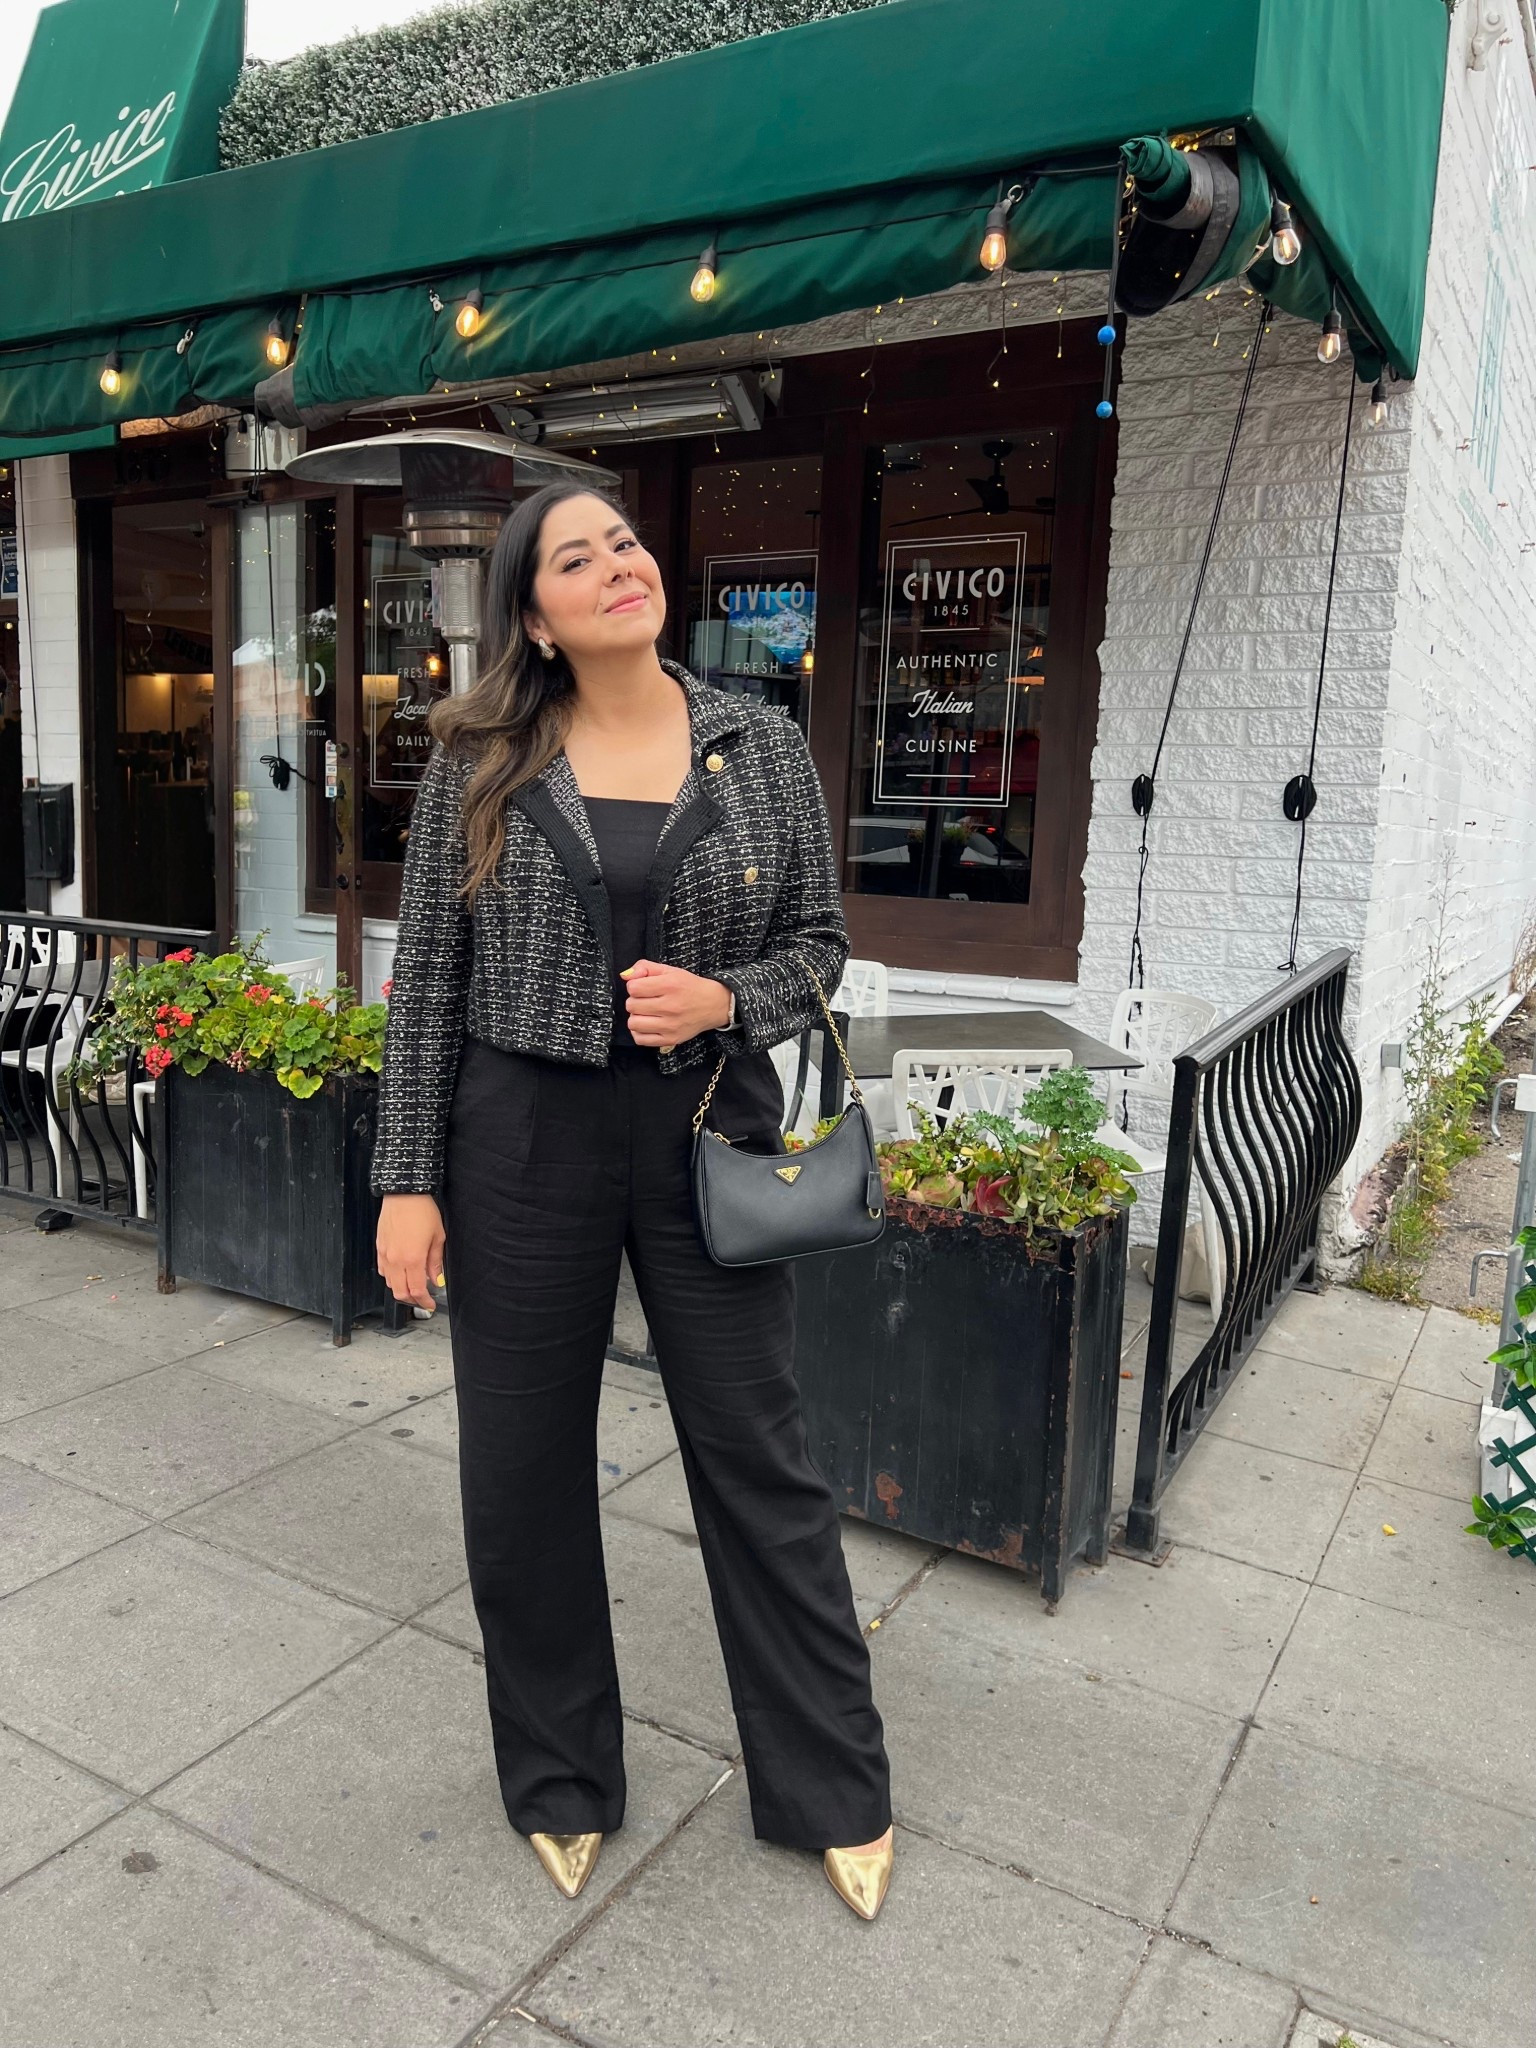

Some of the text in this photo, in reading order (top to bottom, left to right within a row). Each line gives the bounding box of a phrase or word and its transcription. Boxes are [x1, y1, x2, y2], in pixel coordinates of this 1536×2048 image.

[0, 91, 176, 221] Civico
[902, 567, 1005, 602] CIVICO
[718, 581, 806, 612] CIVICO
[934, 604, 969, 617] 1845
[404, 628, 428, 637] 1845
[734, 661, 779, 674] FRESH
[896, 653, 998, 669] AUTHENTIC
[397, 667, 430, 679] FRESH
[394, 696, 433, 721] Local
[908, 689, 974, 718] Italian
[397, 735, 431, 747] DAILY
[905, 739, 977, 753] CUISINE
